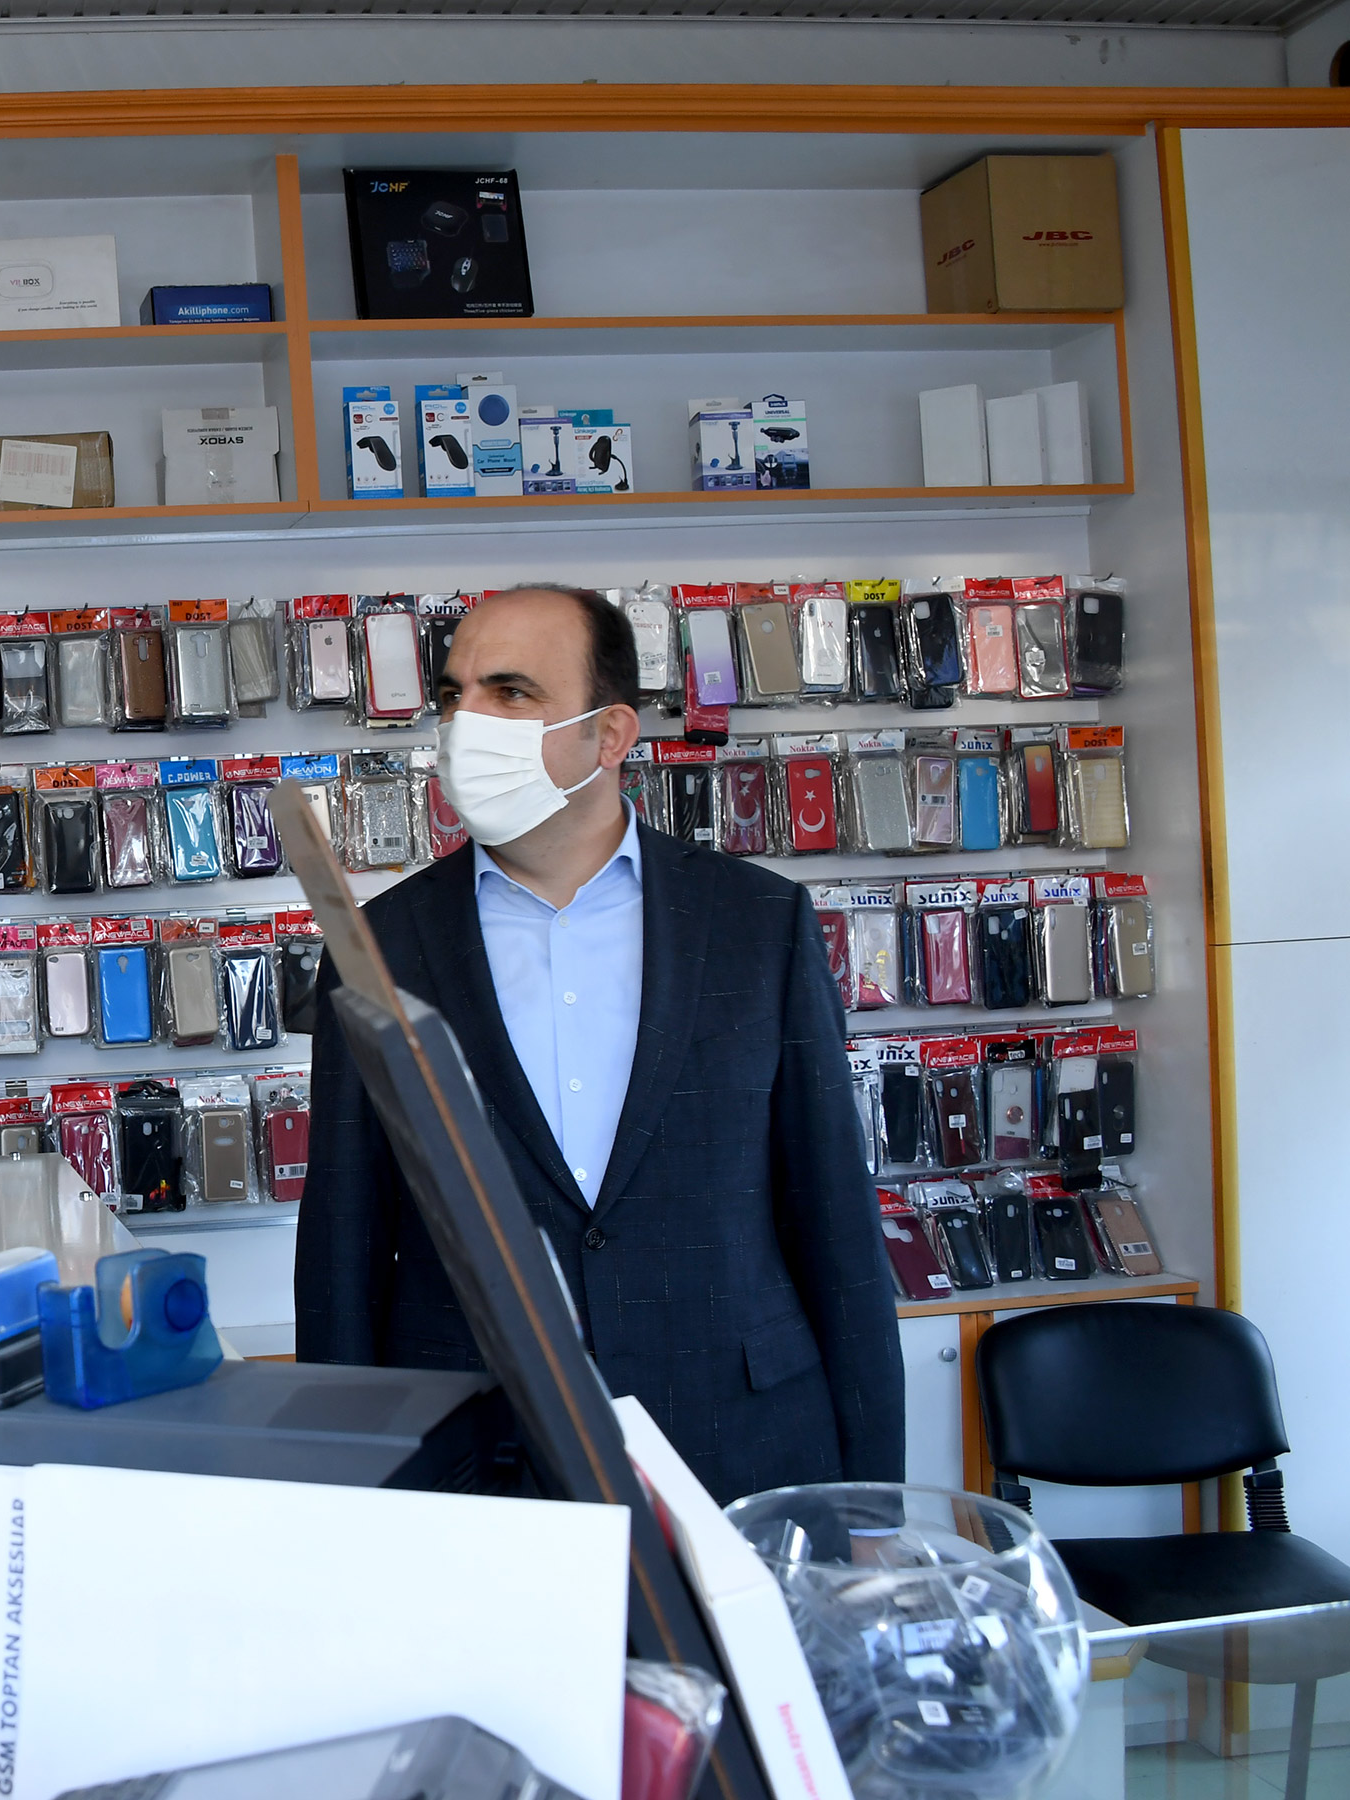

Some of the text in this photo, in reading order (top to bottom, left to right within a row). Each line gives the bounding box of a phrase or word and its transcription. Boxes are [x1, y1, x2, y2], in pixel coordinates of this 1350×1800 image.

[475, 177, 509, 185] JCHF-68
[370, 181, 408, 194] JCHF
[1022, 231, 1093, 241] JBC
[937, 239, 975, 266] JBC
[23, 278, 41, 286] BOX
[178, 306, 249, 316] Akilliphone.com
[200, 436, 244, 445] SYROX
[863, 592, 885, 600] DOST
[185, 612, 211, 620] DOST
[1, 623, 46, 632] NEWFACE
[66, 622, 92, 631] DOST
[858, 740, 882, 748] Nokta
[1083, 738, 1108, 747] DOST
[789, 745, 815, 753] Nokta
[669, 750, 713, 759] NEWFACE
[233, 766, 279, 776] NEWFACE
[167, 771, 212, 783] C.POWER
[52, 779, 79, 788] DOST
[1113, 884, 1144, 893] NEWFACE
[107, 929, 150, 940] NEWFACE
[225, 933, 271, 943] NEWFACE
[1100, 1040, 1134, 1049] NEWFACE
[62, 1099, 109, 1109] NEWFACE
[5, 1111, 44, 1120] NEWFACE
[6, 1497, 25, 1626] AKSESUAR
[0, 1632, 22, 1730] TOPTAN
